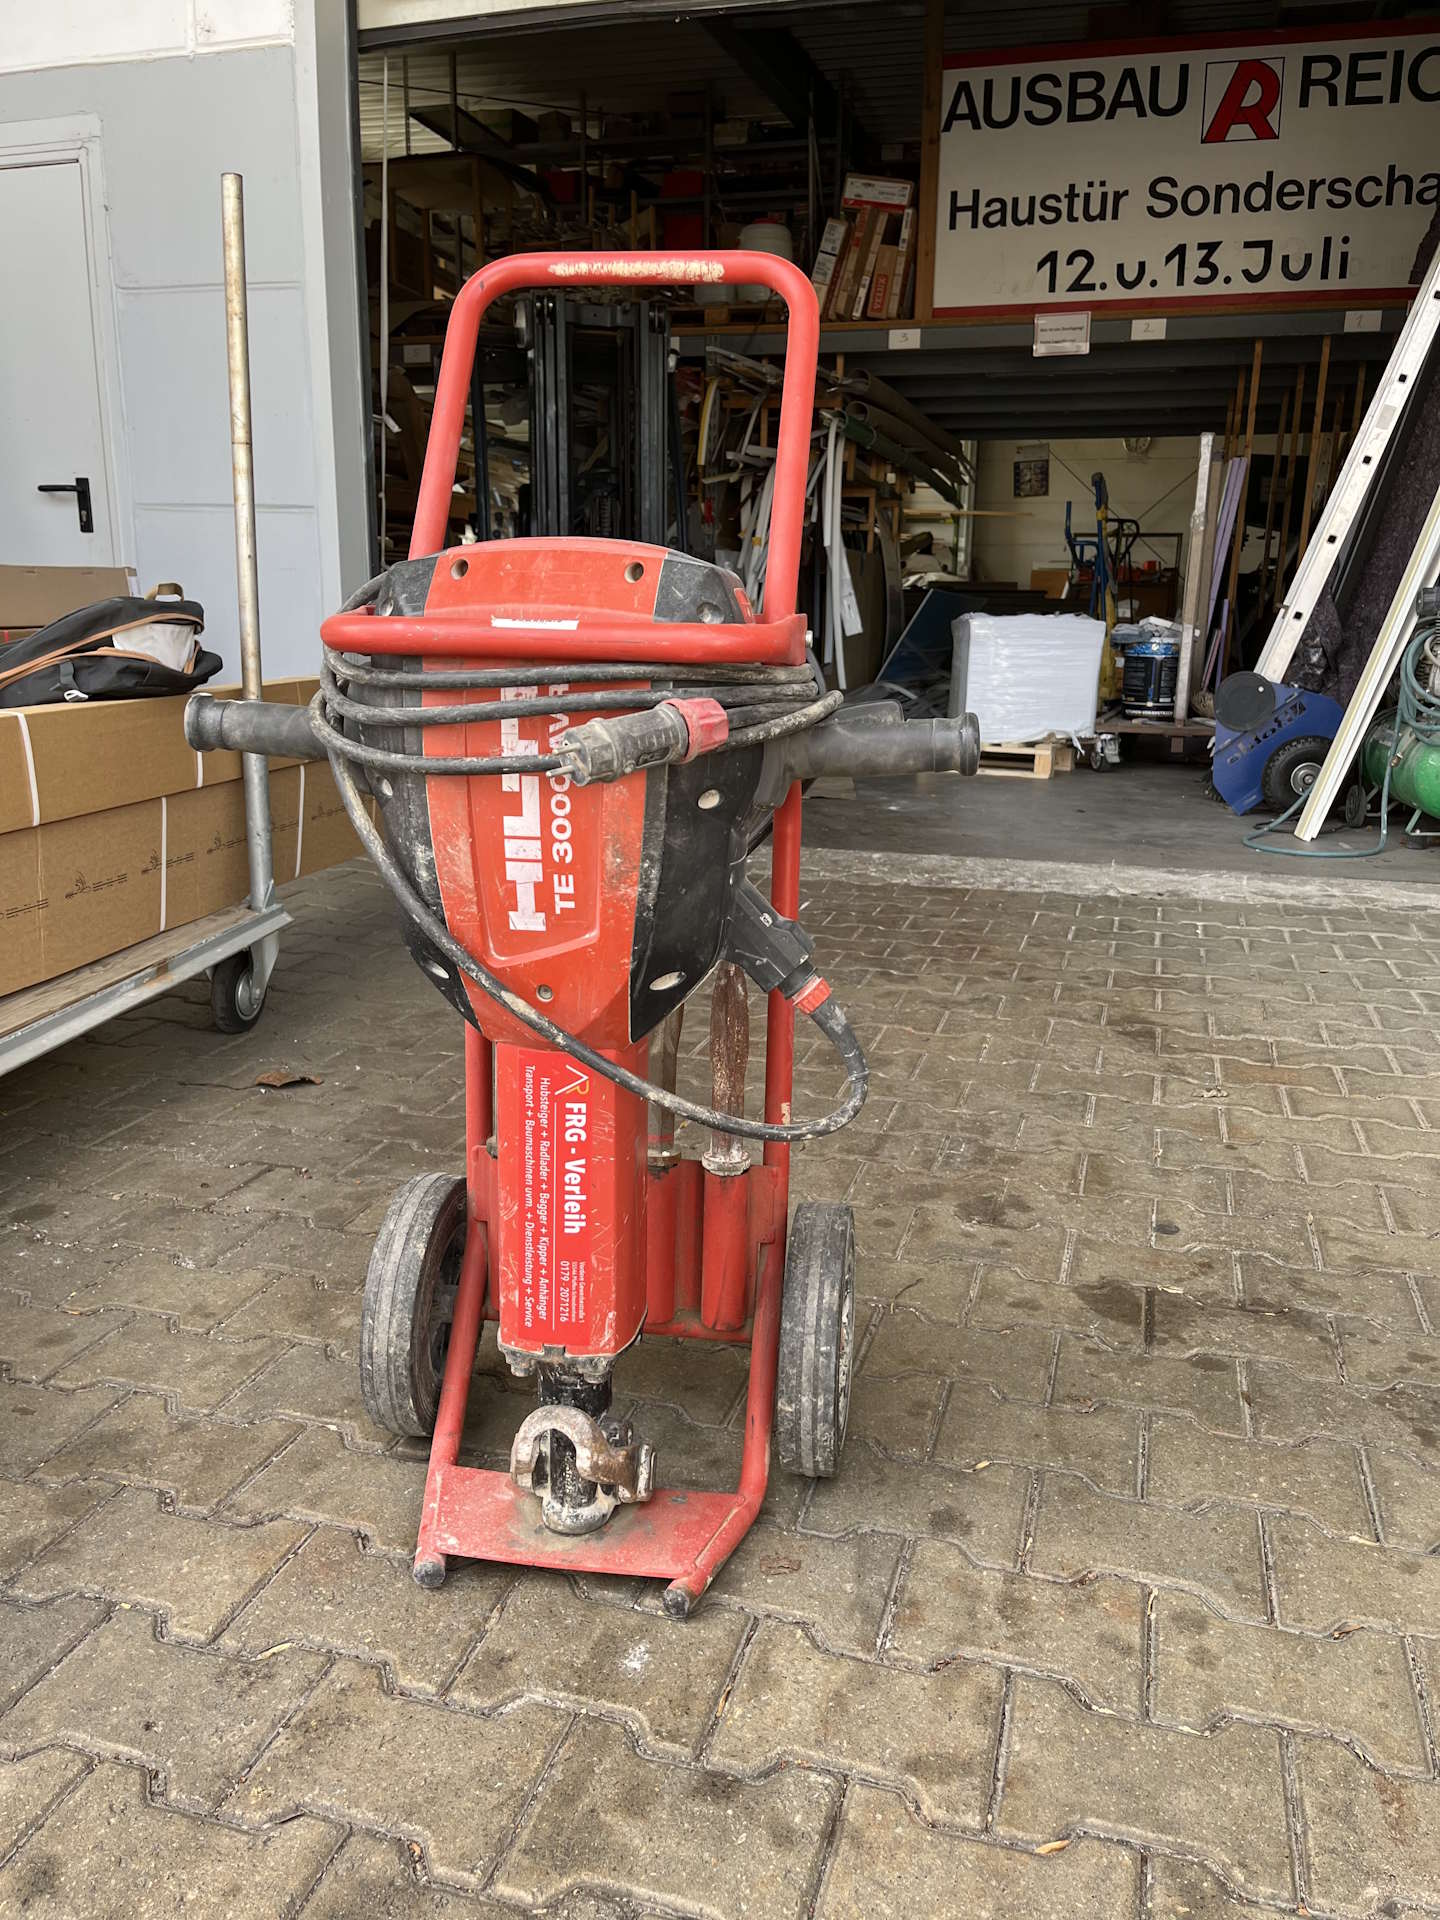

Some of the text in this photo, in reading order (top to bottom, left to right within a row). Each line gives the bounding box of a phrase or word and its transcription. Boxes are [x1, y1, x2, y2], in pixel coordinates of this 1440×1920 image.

[942, 63, 1190, 132] AUSBAU
[1298, 46, 1440, 108] REIC
[949, 180, 1129, 230] Haustür
[1146, 164, 1440, 218] Sonderscha
[501, 686, 546, 931] HILTI
[552, 874, 576, 914] TE
[522, 1065, 536, 1107] Transport
[537, 1077, 551, 1128] Hubsteiger
[565, 1102, 587, 1142] FRG
[525, 1119, 536, 1185] Baumaschinen
[539, 1140, 551, 1181] Radlader
[536, 1192, 550, 1225] Bagger
[564, 1158, 587, 1234] Verleih
[521, 1221, 535, 1285] Dienstleistung
[536, 1236, 550, 1266] Kipper
[560, 1260, 570, 1282] 0179
[524, 1296, 535, 1328] Service
[536, 1277, 549, 1320] Anhänger
[559, 1287, 570, 1322] 2071216
